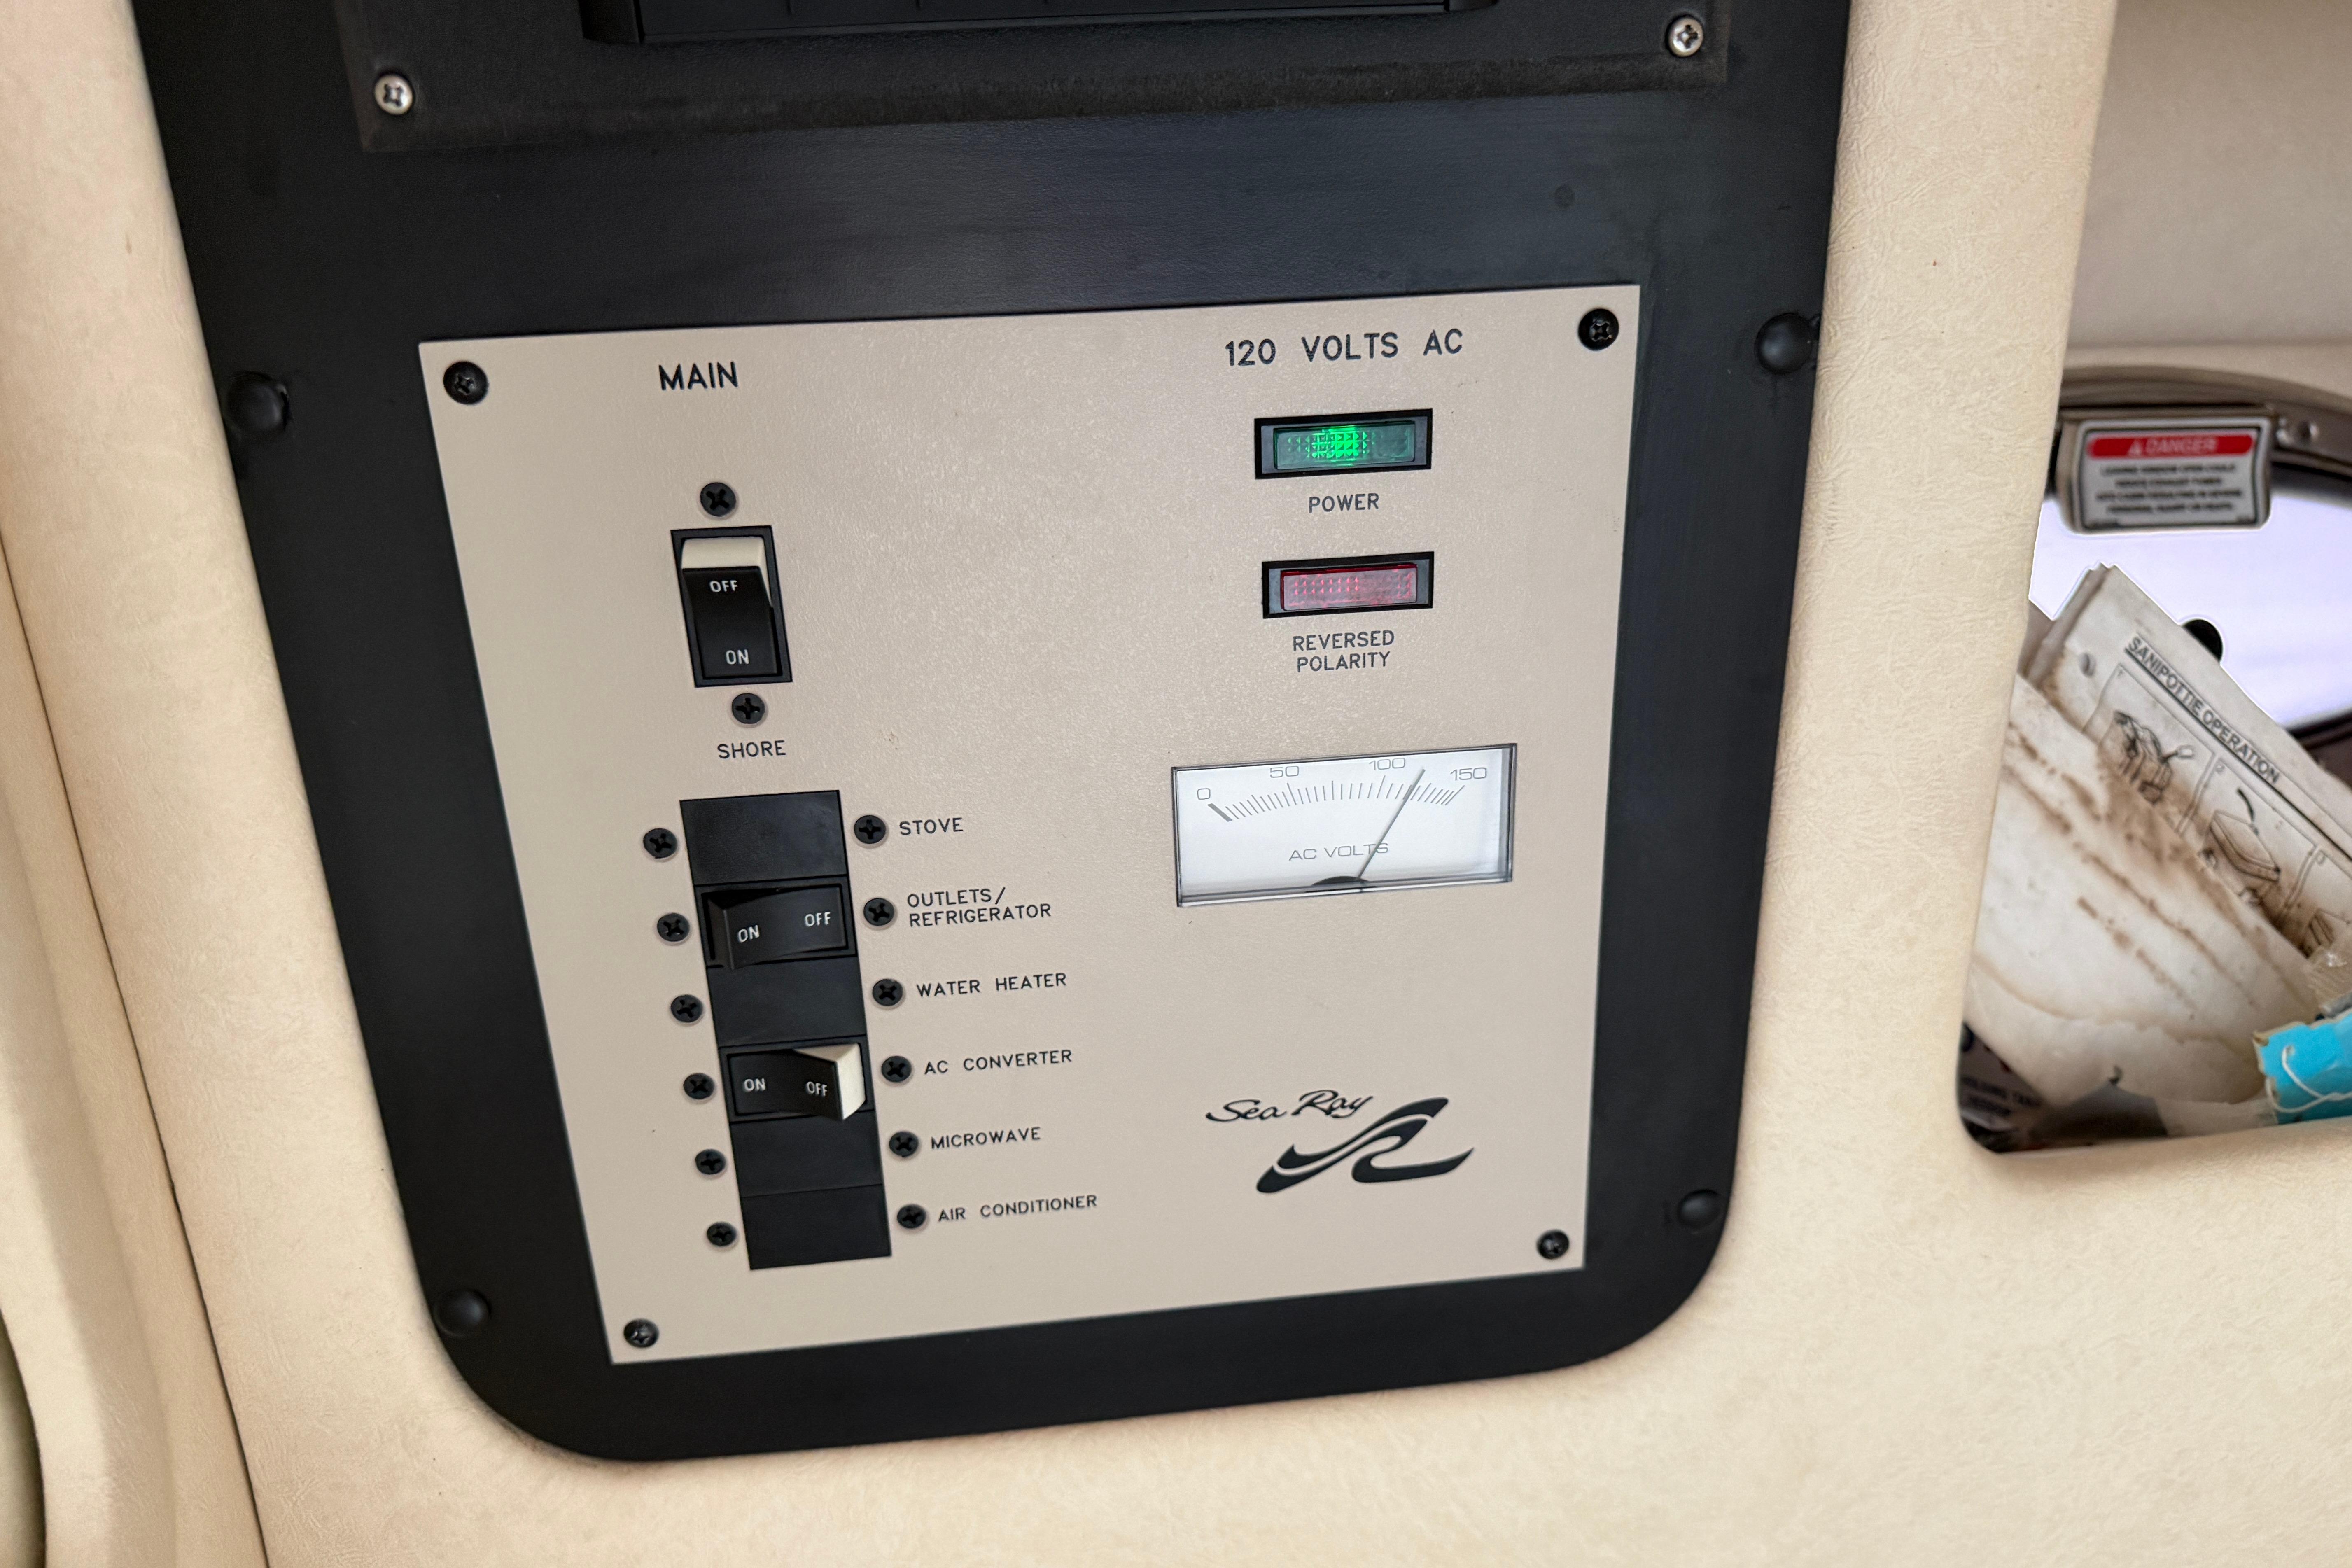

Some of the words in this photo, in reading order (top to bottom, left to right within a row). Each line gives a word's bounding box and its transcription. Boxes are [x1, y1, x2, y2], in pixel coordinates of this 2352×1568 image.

[1225, 338, 1276, 366] 120
[1301, 332, 1398, 362] VOLTS
[1423, 328, 1463, 356] AC
[658, 361, 738, 390] MAIN
[1309, 493, 1379, 513] POWER
[709, 580, 737, 593] OFF
[1293, 630, 1395, 651] REVERSED
[726, 649, 749, 665] ON
[1297, 651, 1391, 673] POLARITY
[2129, 637, 2204, 717] SANIPOTTIE
[2202, 709, 2280, 784] OPERATION
[717, 740, 786, 759] SHORE
[1269, 765, 1300, 779] 50
[1368, 757, 1407, 771] 100
[1450, 767, 1488, 781] 150
[1197, 788, 1211, 800] 0
[899, 817, 964, 836] STOVE
[1288, 849, 1317, 861] AC
[1324, 843, 1388, 858] VOLTS
[907, 887, 1006, 908] OUTLETS/
[805, 912, 831, 927] OFF
[908, 903, 1051, 927] REFRIGERATOR
[738, 925, 759, 943] ON
[916, 980, 980, 997] WATER
[996, 973, 1066, 991] HEATER
[924, 1060, 948, 1075] AC
[963, 1049, 1071, 1071] CONVERTER
[744, 1078, 766, 1092] ON
[806, 1081, 827, 1096] OFF
[1205, 1099, 1286, 1122] Sea
[1291, 1090, 1373, 1119] Ray
[931, 1127, 1040, 1149] MICROWAVE
[938, 1207, 965, 1222] AIR
[980, 1195, 1097, 1218] CONDITIONER
